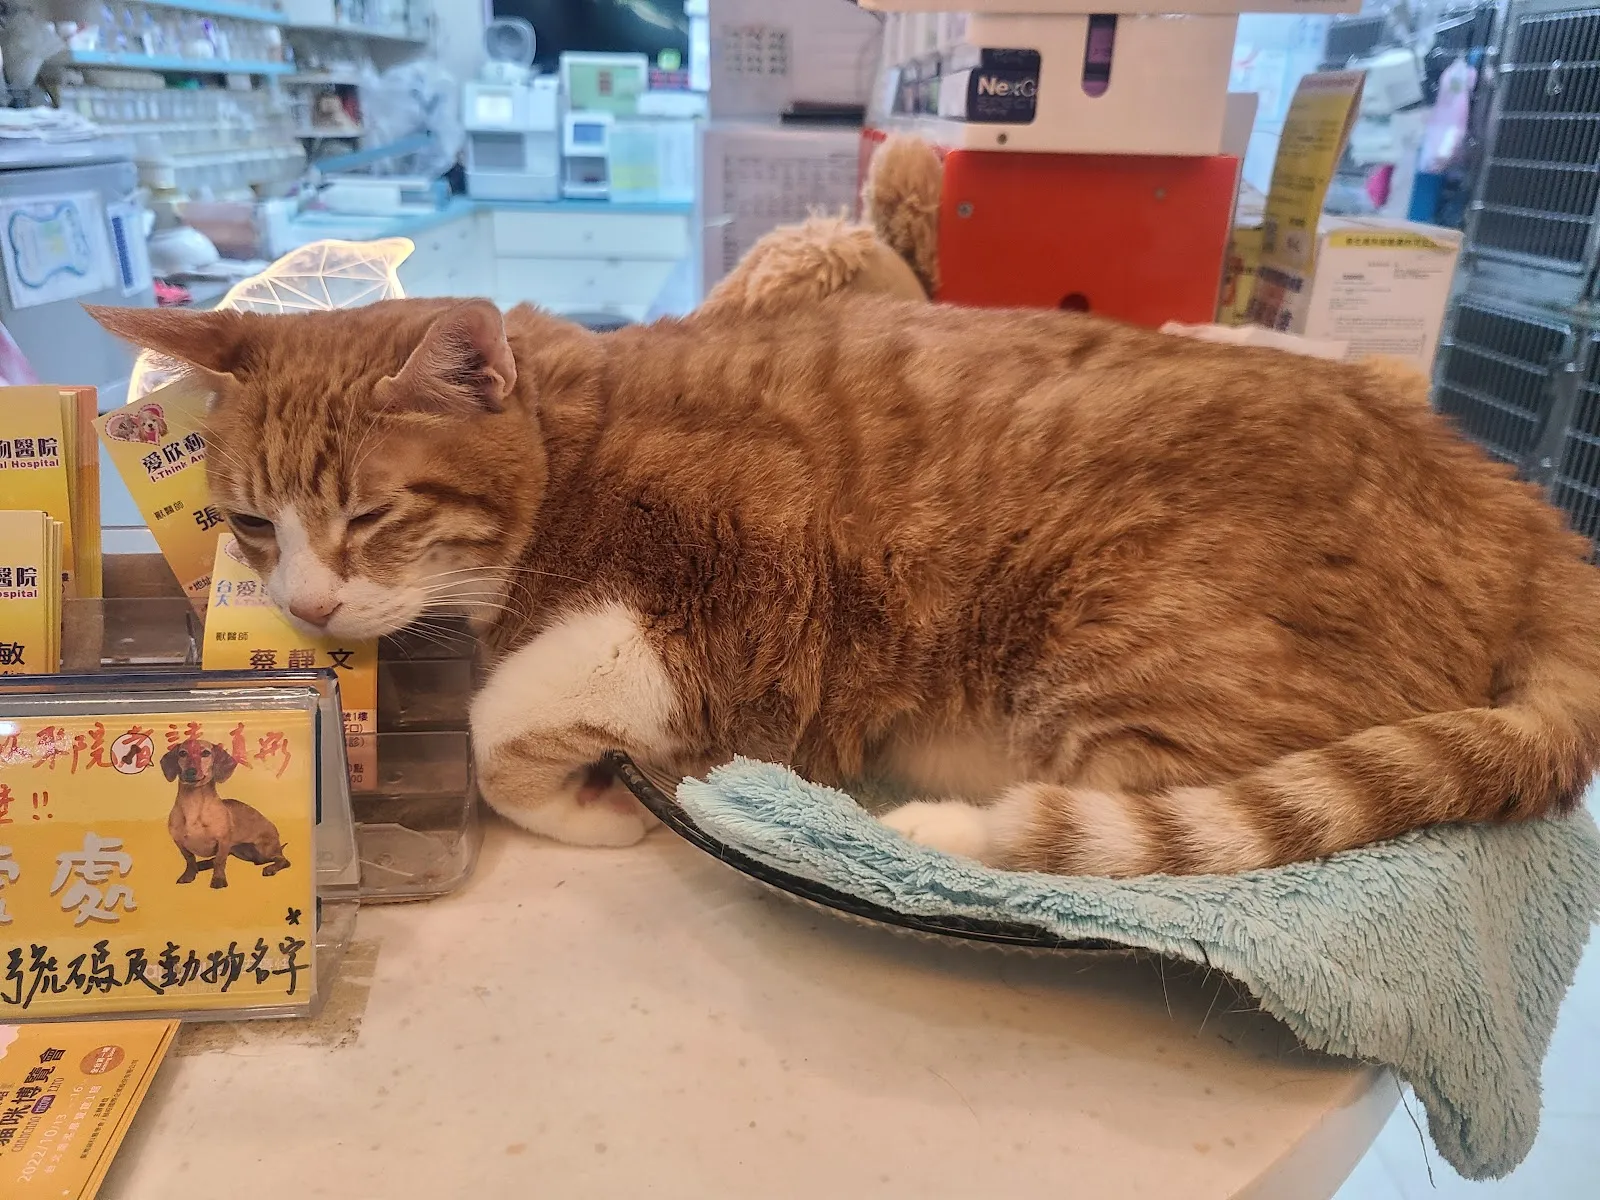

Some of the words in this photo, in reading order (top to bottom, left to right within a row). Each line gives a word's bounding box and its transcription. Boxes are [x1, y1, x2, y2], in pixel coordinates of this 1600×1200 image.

[11, 459, 59, 469] Hospital
[151, 460, 187, 483] I-Think
[153, 500, 184, 520] 獸醫師
[193, 504, 225, 532] 張
[216, 632, 249, 641] 獸醫師
[249, 648, 355, 670] 蔡靜文
